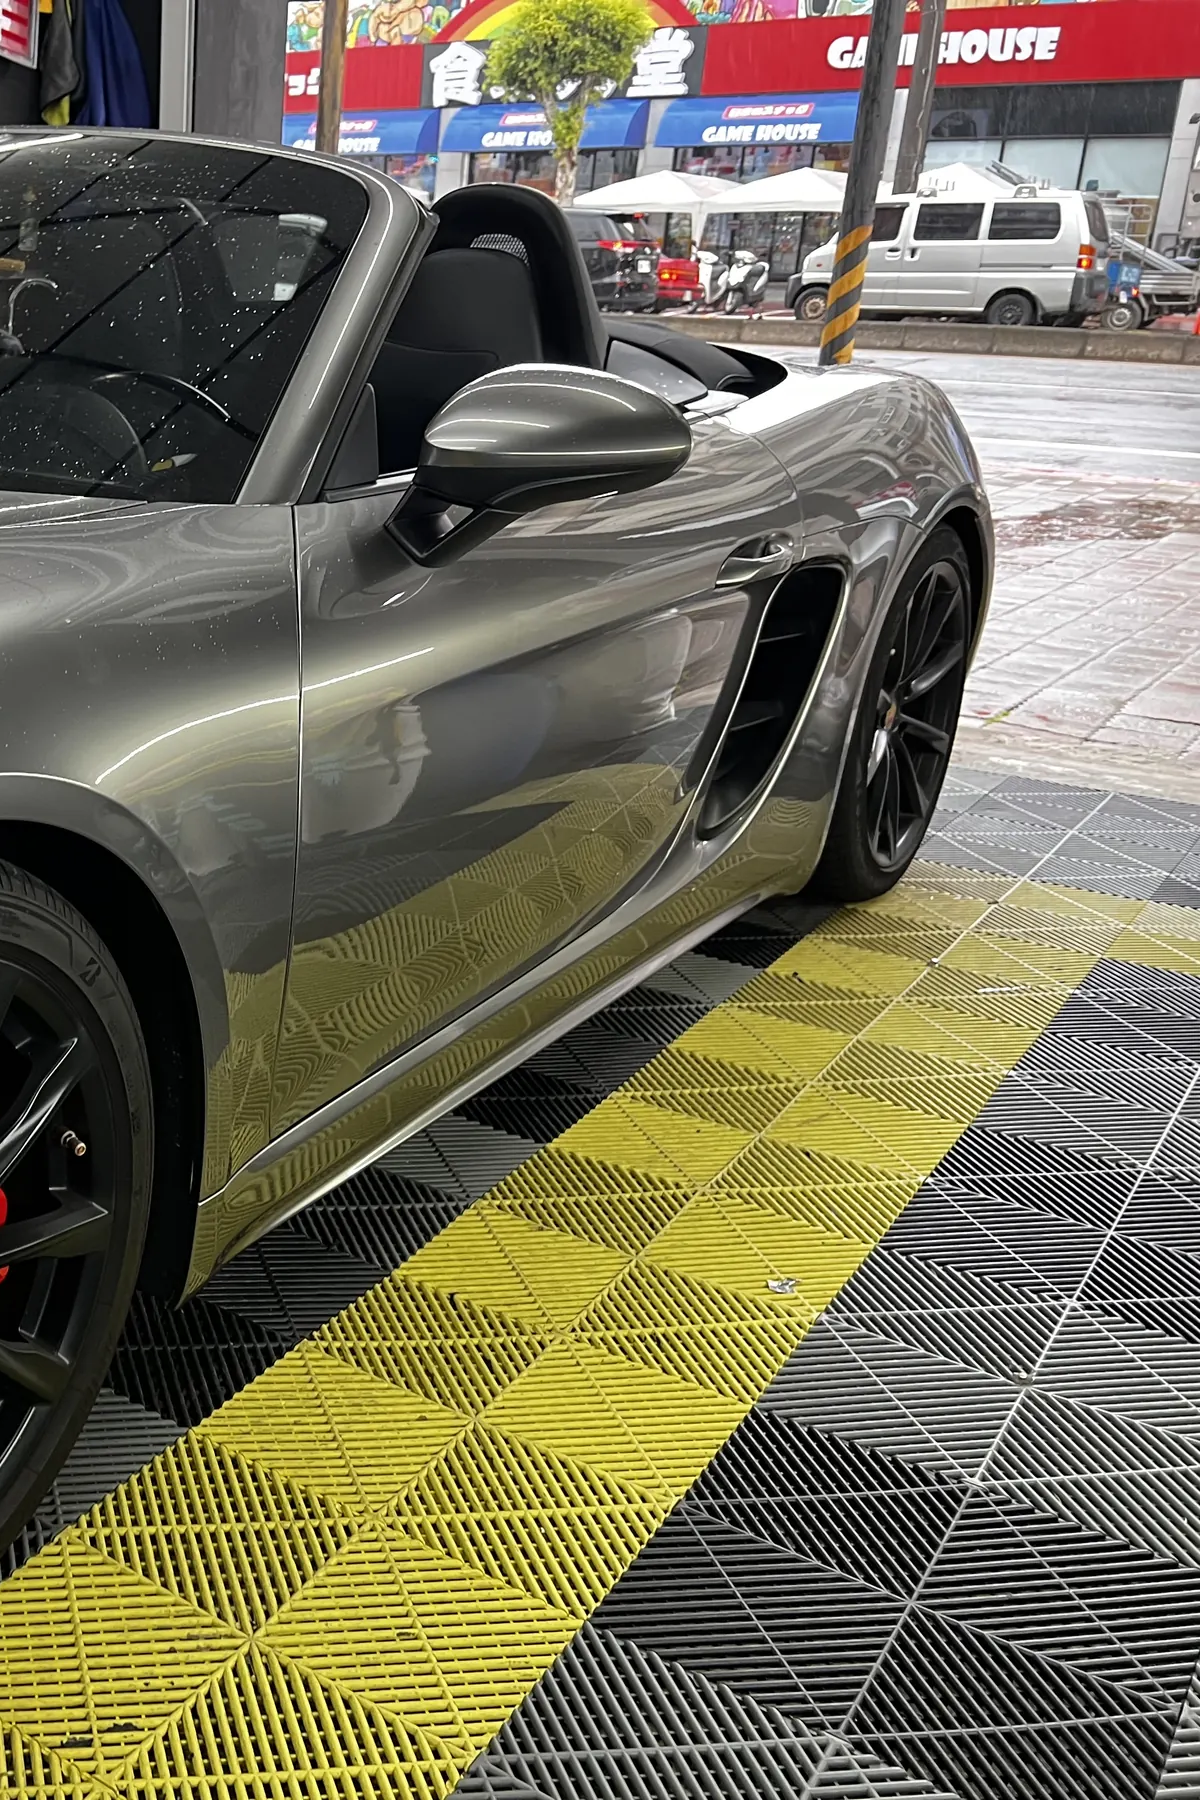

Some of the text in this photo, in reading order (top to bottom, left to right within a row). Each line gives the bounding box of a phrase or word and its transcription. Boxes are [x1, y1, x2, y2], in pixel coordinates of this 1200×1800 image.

[937, 27, 1061, 65] HOUSE
[481, 131, 527, 147] GAME
[701, 123, 822, 143] GAME HOUSE
